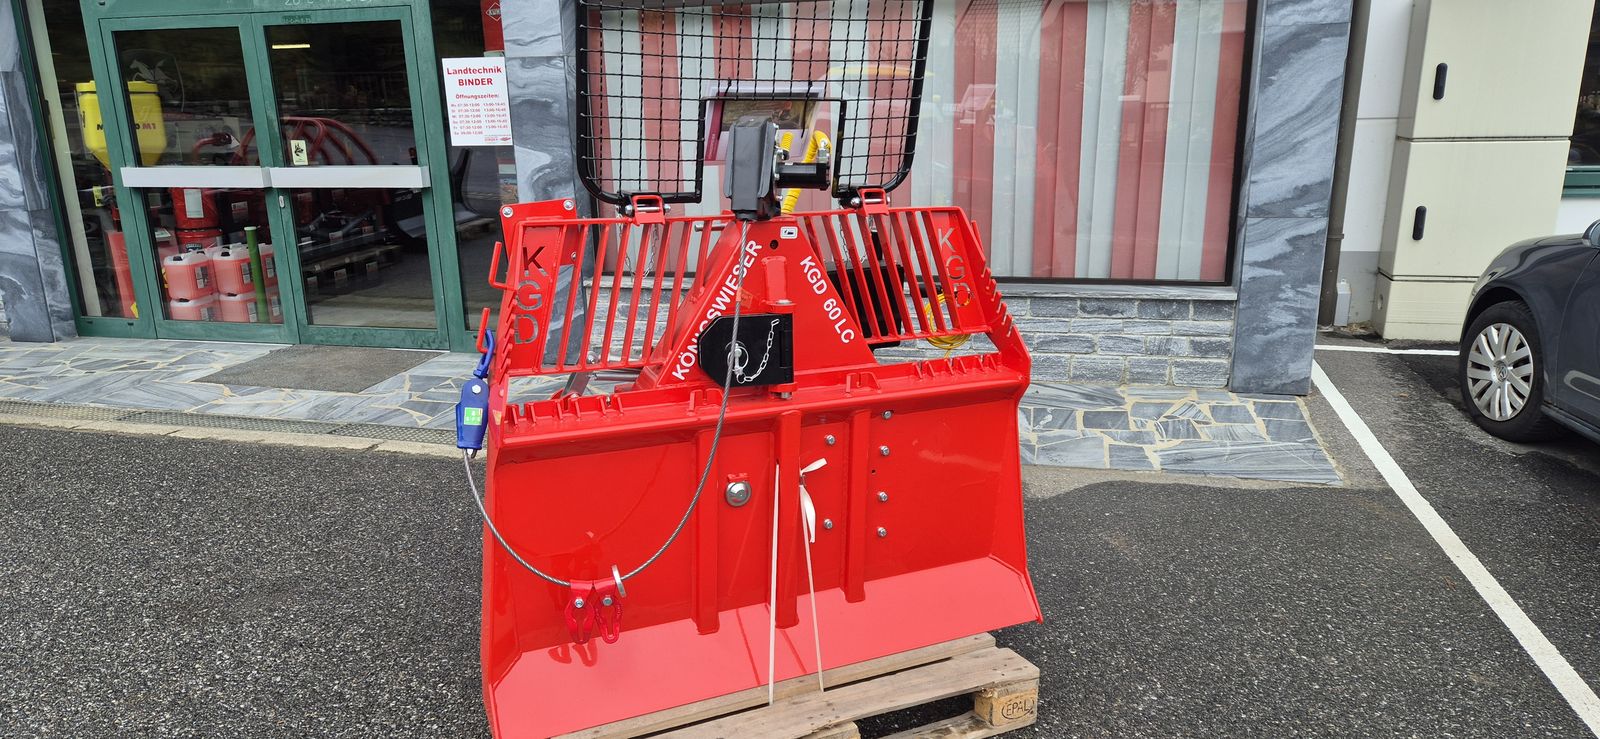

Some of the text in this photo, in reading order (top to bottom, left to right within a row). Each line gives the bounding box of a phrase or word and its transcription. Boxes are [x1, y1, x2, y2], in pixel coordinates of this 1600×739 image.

[446, 66, 502, 75] Landtechnik
[458, 78, 493, 86] BINDER
[938, 227, 972, 308] KGD
[513, 245, 548, 345] KGD
[800, 256, 855, 344] KGD 60 LC
[1006, 699, 1031, 716] EPAL
